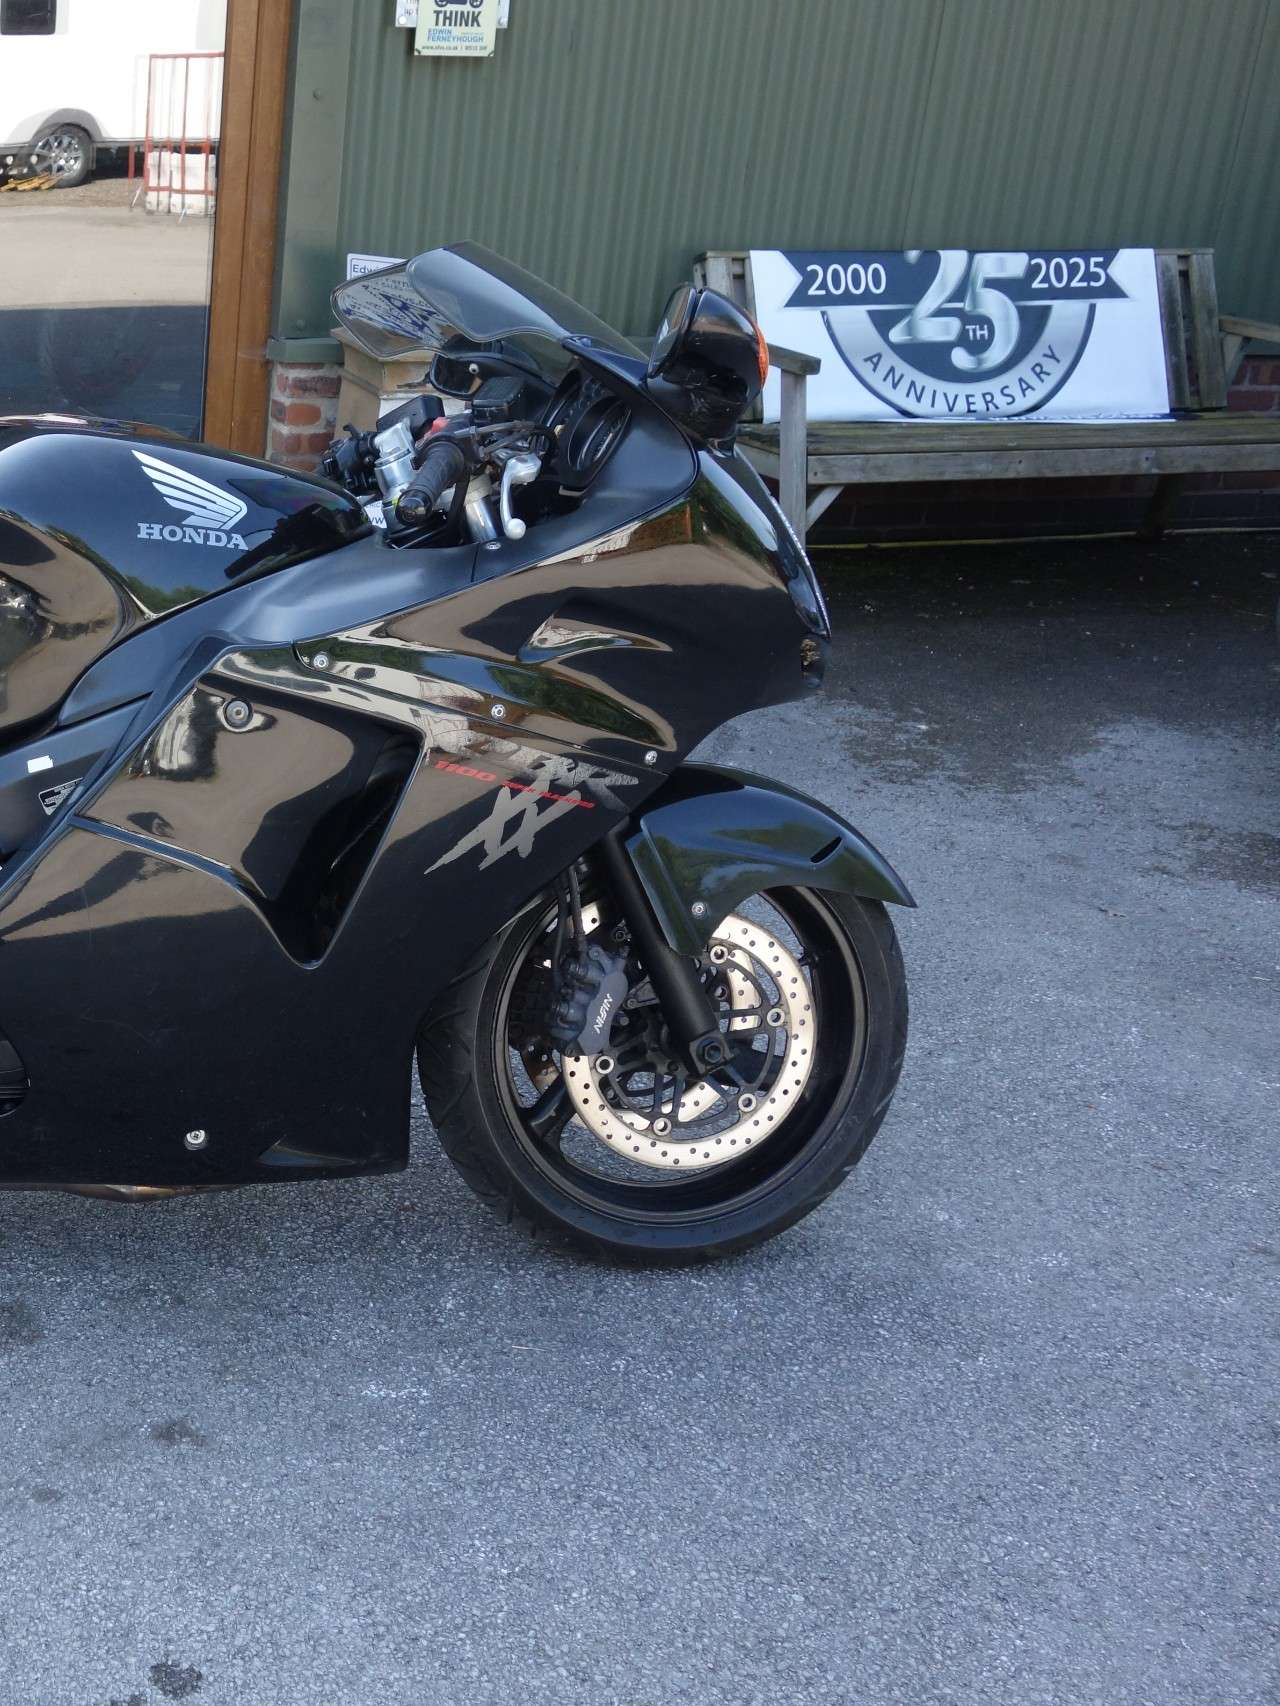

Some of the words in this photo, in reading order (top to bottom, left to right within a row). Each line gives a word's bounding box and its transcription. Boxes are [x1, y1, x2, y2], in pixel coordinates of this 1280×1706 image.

[433, 10, 482, 27] THINK
[427, 35, 484, 43] FERNEYHOUGH
[806, 263, 886, 296] 2000
[888, 250, 1029, 372] 25
[1030, 256, 1106, 289] 2025
[966, 325, 988, 341] TH
[863, 345, 1061, 414] ANNIVERSARY
[137, 522, 249, 550] HONDA
[434, 760, 497, 782] 1100
[424, 775, 582, 875] XX
